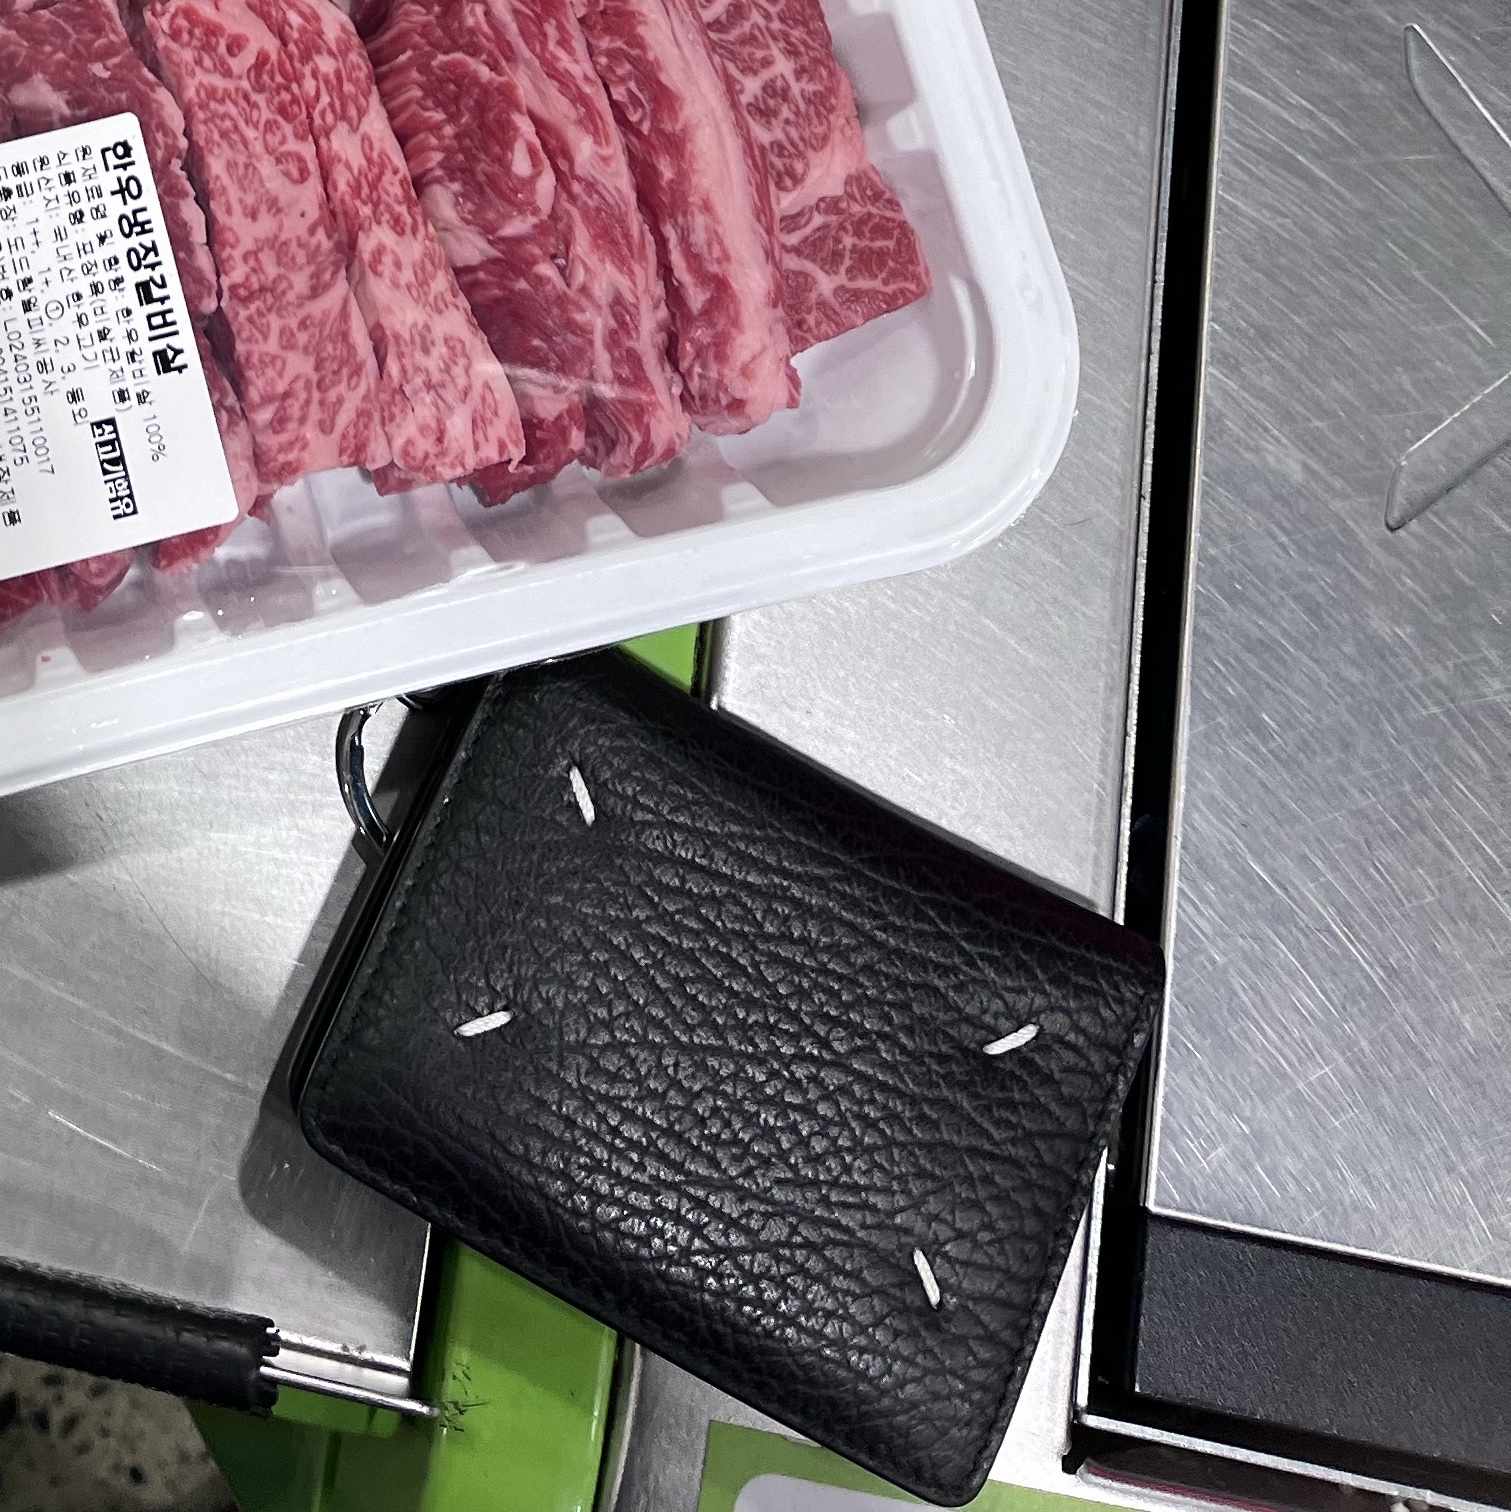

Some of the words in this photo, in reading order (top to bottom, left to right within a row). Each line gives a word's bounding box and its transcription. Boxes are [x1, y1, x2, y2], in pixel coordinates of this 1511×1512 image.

[33, 156, 59, 212] 원산지:
[54, 226, 74, 282] 국내산
[66, 292, 97, 371] 한우고기
[101, 140, 188, 375] 한우냉장갈비살
[4, 319, 54, 474] L02403155110017
[116, 307, 152, 405] 한우갈비살
[145, 415, 165, 461] 100%
[88, 416, 139, 520] 쇠고기함유
